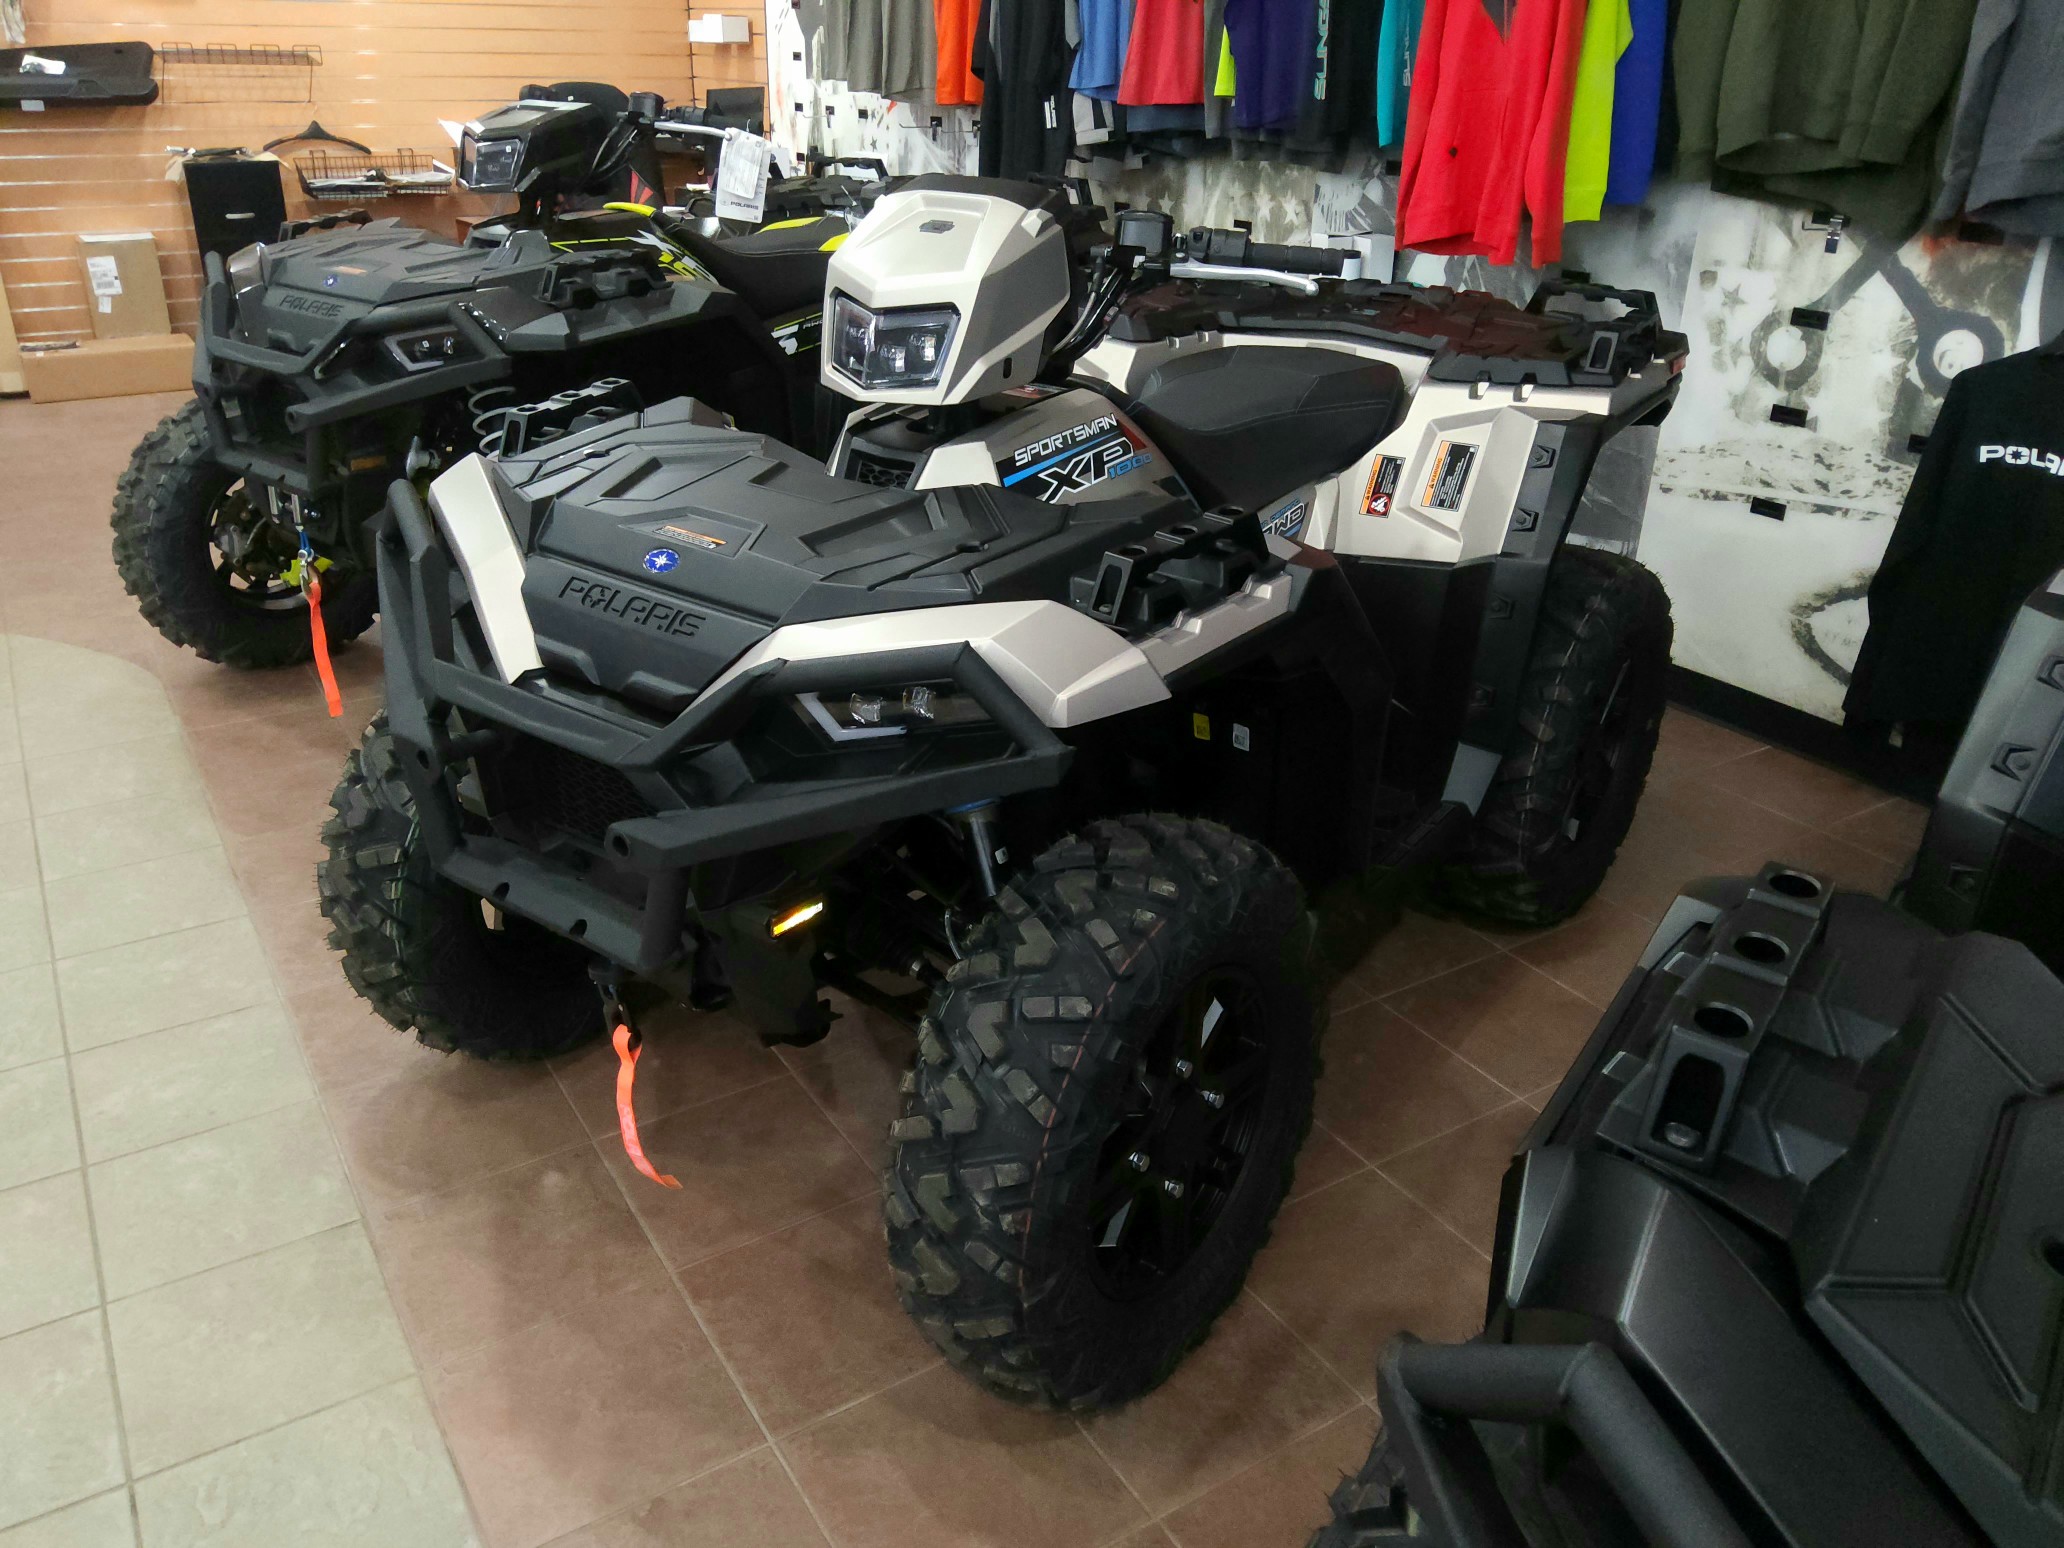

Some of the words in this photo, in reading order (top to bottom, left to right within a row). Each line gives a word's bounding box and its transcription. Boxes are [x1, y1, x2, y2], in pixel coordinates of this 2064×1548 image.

[279, 294, 344, 317] POLARIS
[1014, 413, 1118, 467] SPORTSMAN
[1037, 436, 1134, 504] XP
[1107, 452, 1152, 479] 1000
[1431, 458, 1443, 483] WARNING
[558, 576, 706, 637] POLARIS
